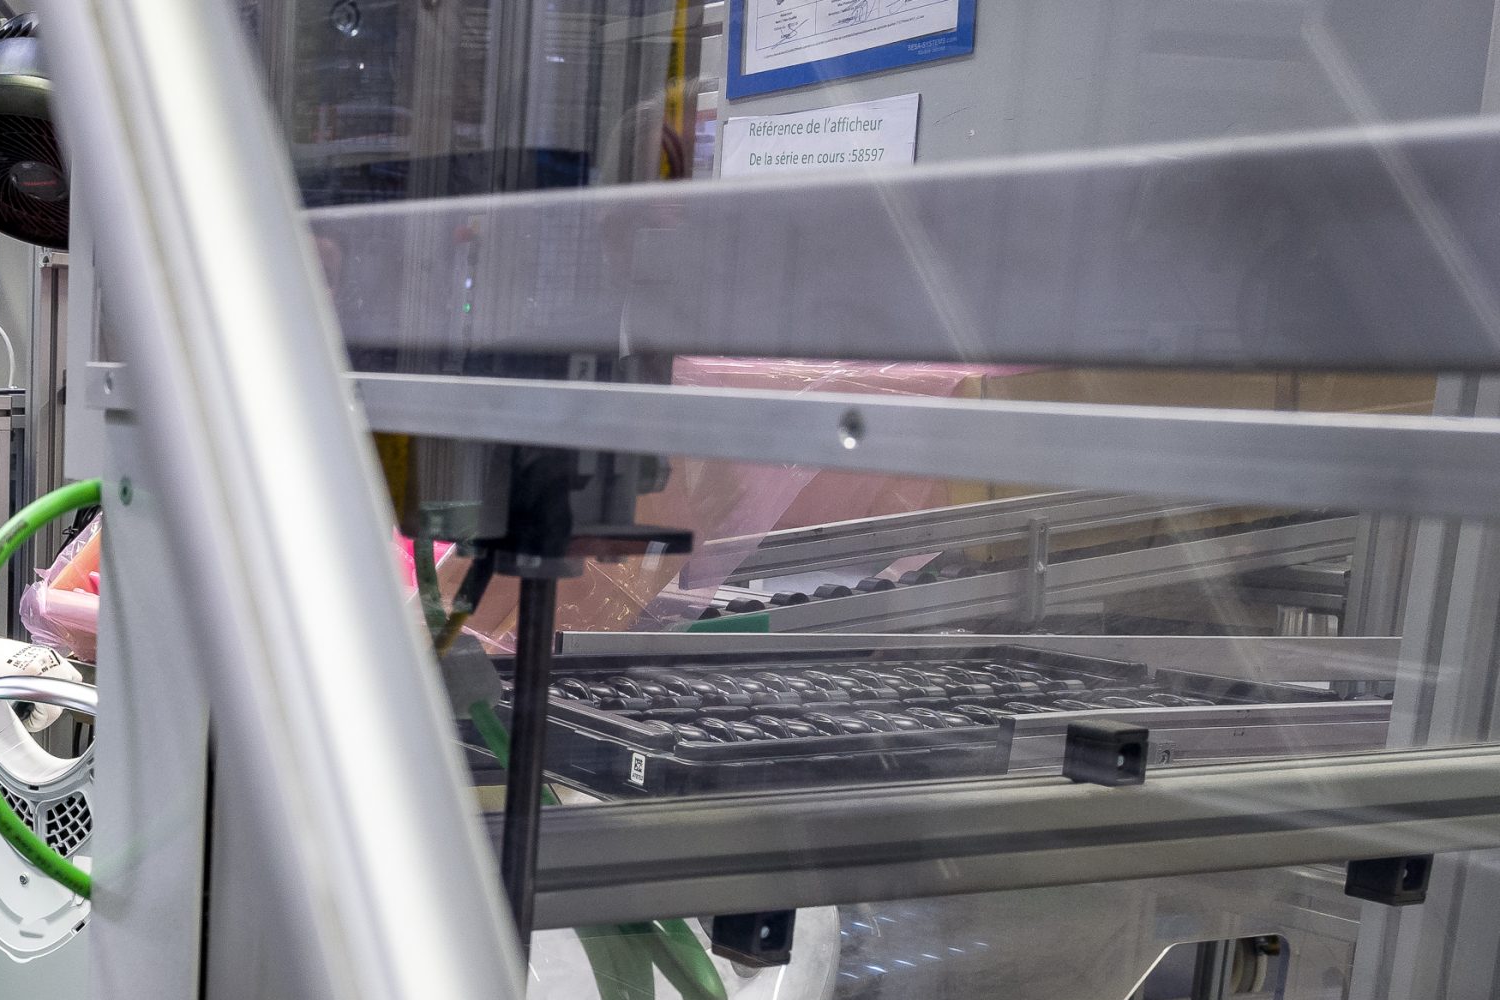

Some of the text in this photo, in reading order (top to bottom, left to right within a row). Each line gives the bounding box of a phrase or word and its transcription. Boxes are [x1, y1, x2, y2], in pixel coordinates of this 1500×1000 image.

[749, 120, 803, 137] Référence
[806, 119, 820, 134] de
[749, 153, 761, 166] De
[764, 152, 772, 165] la
[775, 151, 798, 165] série
[801, 154, 814, 164] en
[817, 152, 845, 164] cours
